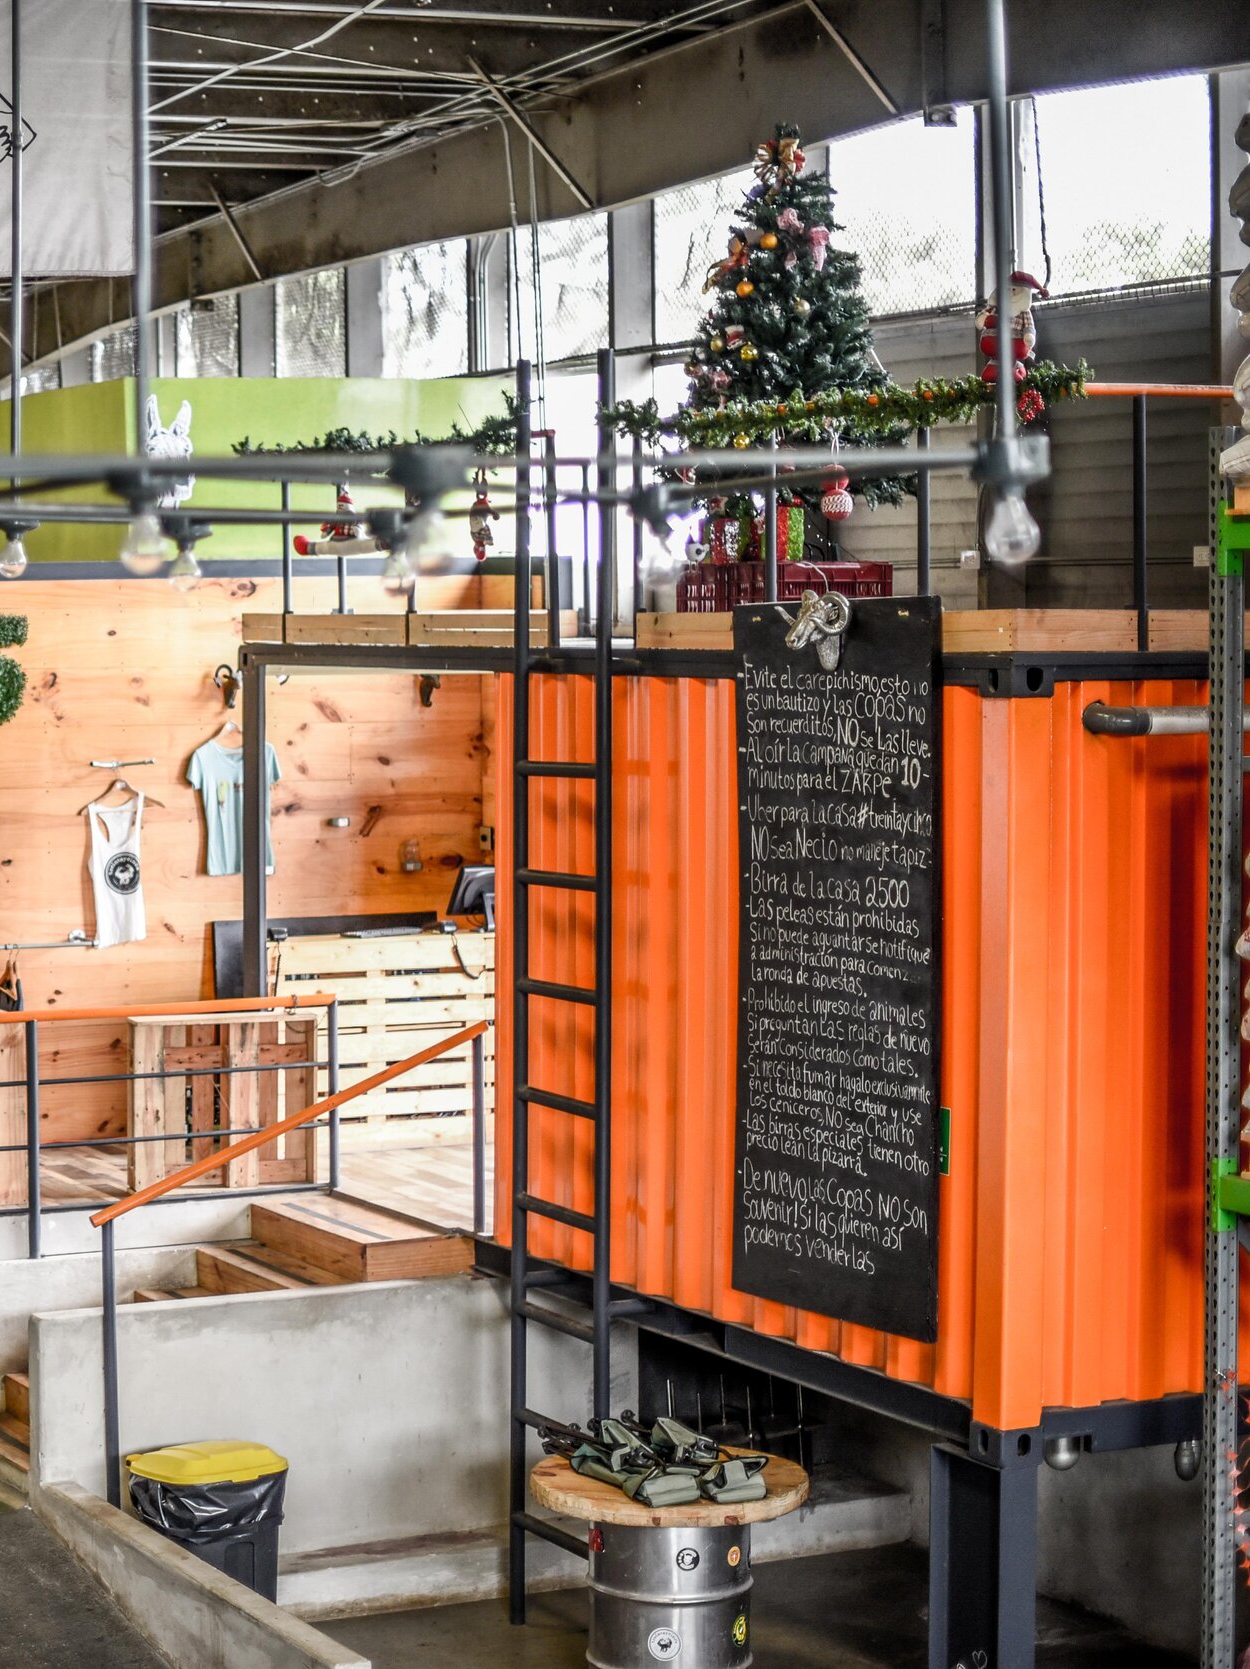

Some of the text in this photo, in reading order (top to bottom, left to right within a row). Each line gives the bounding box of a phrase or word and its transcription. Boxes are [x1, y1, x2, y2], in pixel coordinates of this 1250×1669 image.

[780, 665, 794, 689] el
[908, 705, 926, 725] no
[837, 716, 860, 747] NO
[824, 766, 838, 791] el
[901, 756, 921, 790] 10
[751, 824, 770, 861] NO
[750, 861, 789, 895] Birra
[792, 871, 807, 898] de
[865, 876, 910, 909] 2500
[852, 909, 920, 939] prohibidas
[796, 965, 810, 986] de
[797, 992, 810, 1014] el
[851, 999, 866, 1020] de
[868, 1000, 926, 1029] animales
[882, 1024, 898, 1049] de
[803, 1061, 837, 1090] fumar
[825, 1105, 843, 1129] NO
[891, 1107, 898, 1128] y
[904, 1150, 930, 1177] otro
[878, 1192, 901, 1223] NO
